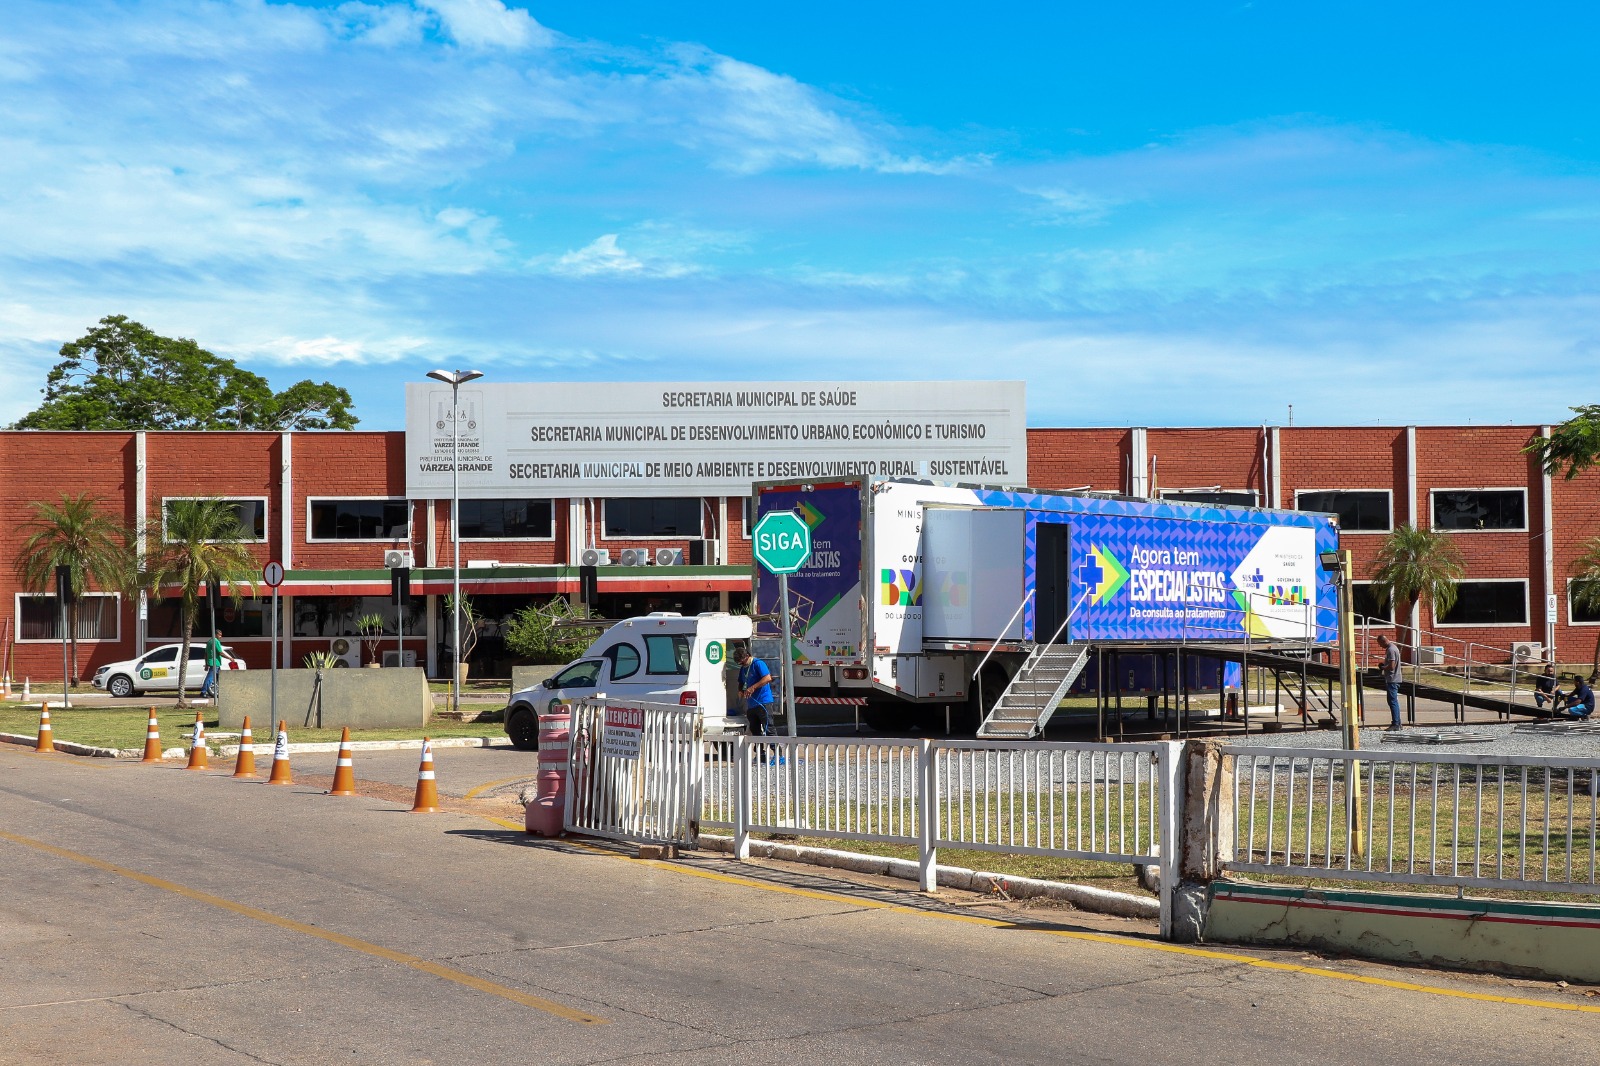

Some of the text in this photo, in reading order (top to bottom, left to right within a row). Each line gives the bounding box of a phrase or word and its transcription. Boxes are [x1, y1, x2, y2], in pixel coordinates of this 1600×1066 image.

[663, 387, 857, 407] SECRETARIA MUNICIPAL DE SAÚDE
[531, 426, 602, 442] SECRETARIA
[606, 426, 667, 441] MUNICIPAL
[671, 426, 685, 441] DE
[690, 425, 799, 440] DESENVOLVIMENTO
[853, 420, 922, 439] ECONÔMICO
[925, 425, 932, 439] E
[935, 424, 986, 439] TURISMO
[420, 463, 454, 471] VÁRZEA
[510, 456, 1009, 479] SECRETARIA MUNICIPAL DE MEIO AMBIENTE E DESENVOLVIMENTO RURAL SUSTENTÁVEL
[897, 510, 922, 519] MINIS
[760, 532, 804, 551] SIGA
[813, 539, 831, 549] tem
[1131, 544, 1199, 569] Agora tem
[1130, 569, 1226, 602] ESPECIALISTAS
[1268, 585, 1310, 605] BRASIL
[1130, 607, 1226, 619] Da consulta ao tratamento
[606, 710, 641, 726] ATENÇÃO!
